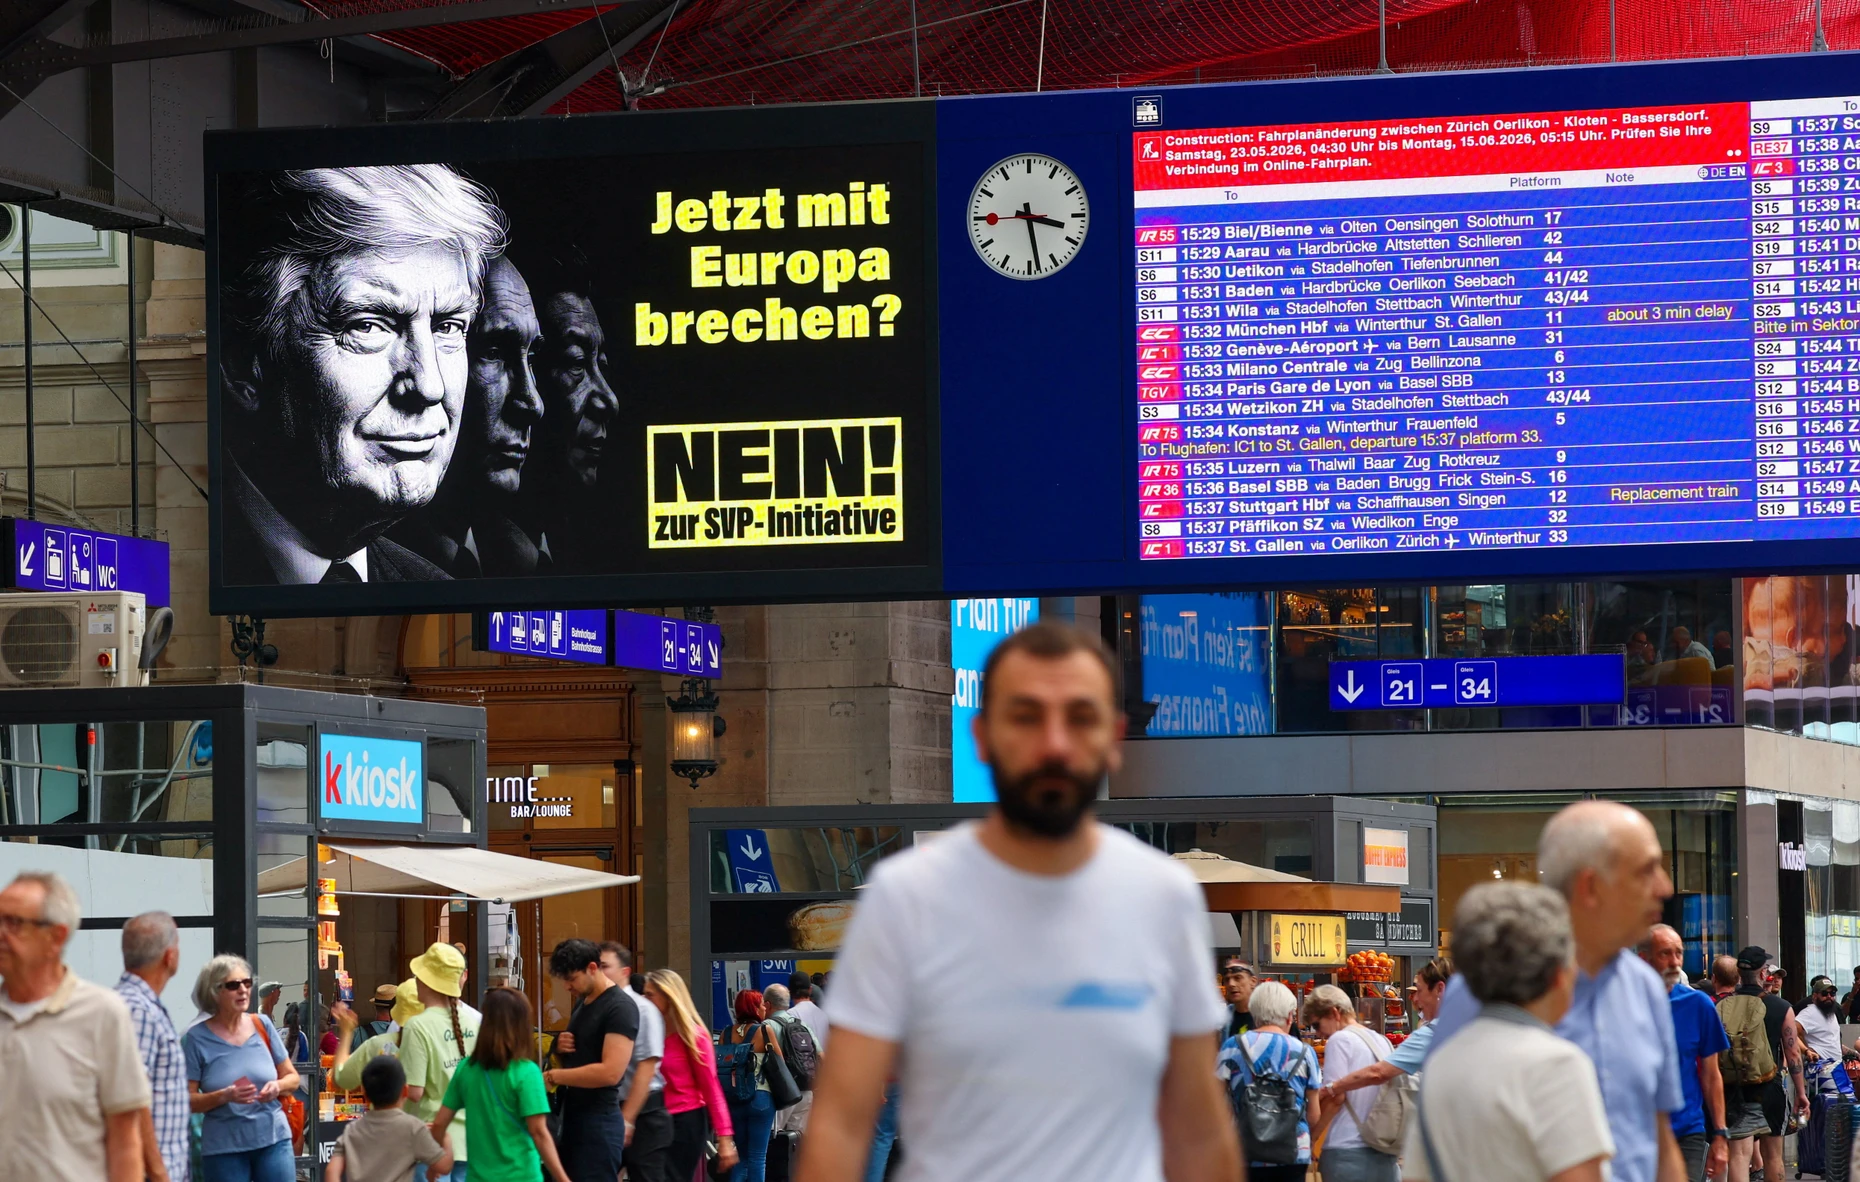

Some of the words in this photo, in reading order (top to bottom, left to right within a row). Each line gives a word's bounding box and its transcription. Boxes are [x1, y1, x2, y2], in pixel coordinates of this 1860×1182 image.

[1843, 100, 1858, 111] To
[1165, 132, 1254, 146] Construction:
[1258, 127, 1377, 143] Fahrplanänderung
[1381, 123, 1442, 136] zwischen
[1446, 120, 1489, 132] Zürich
[1493, 118, 1549, 130] Oerlikon
[1564, 116, 1607, 127] Kloten
[1622, 109, 1708, 124] Bassersdorf.
[1753, 122, 1770, 134] S9
[1797, 117, 1838, 132] 15:37
[1165, 149, 1226, 161] Samstag,
[1230, 144, 1306, 158] 23.05.2026,
[1310, 142, 1346, 154] 04:30
[1351, 141, 1374, 152] Uhr
[1378, 139, 1398, 151] bis
[1402, 138, 1456, 150] Montag,
[1460, 133, 1536, 147] 15.06.2026,
[1540, 131, 1575, 143] 05:15
[1579, 130, 1606, 141] Uhr.
[1611, 127, 1655, 139] Prüfen
[1659, 126, 1680, 137] Sie
[1685, 124, 1712, 136] Ihre
[1165, 163, 1239, 176] Verbindung
[1243, 161, 1258, 172] im
[1262, 156, 1372, 171] Online-Fahrplan.
[1774, 161, 1783, 173] 3
[1797, 158, 1840, 172] 15:38
[1224, 190, 1238, 200] To
[1510, 176, 1561, 187] Platform
[1606, 172, 1634, 183] Note
[1711, 167, 1726, 177] DE
[1729, 166, 1745, 176] EN
[652, 188, 785, 234] Jetzt
[798, 182, 890, 227] mit
[1159, 229, 1175, 242] 55
[1181, 226, 1220, 240] 15:29
[1224, 224, 1313, 240] Biel/Bienne
[1319, 224, 1334, 234] via
[1340, 220, 1377, 233] Olten
[1385, 217, 1458, 232] Oensingen
[1467, 214, 1534, 228] Solothurn
[1544, 211, 1562, 224] 17
[1140, 250, 1162, 262] S11
[1181, 246, 1220, 260] 15:29
[1224, 245, 1269, 258] Aarau
[1276, 245, 1291, 256] via
[1298, 239, 1377, 255] Hardbrücke
[1384, 237, 1450, 251] Altstetten
[1457, 234, 1522, 248] Schlieren
[1543, 231, 1562, 244] 42
[691, 246, 890, 292] Europa
[635, 294, 902, 346] brechen?
[1140, 327, 1175, 340] EC
[1182, 324, 1222, 338] 15:32
[1226, 322, 1296, 337] München
[1300, 320, 1328, 334] Hbf
[1334, 322, 1349, 332] via
[1355, 316, 1427, 331] Winterthur
[1434, 315, 1453, 328] St.
[1457, 313, 1502, 327] Gallen
[1545, 310, 1562, 324] 11
[1607, 308, 1648, 321] about
[1652, 306, 1661, 319] 3
[1665, 305, 1691, 319] min
[1695, 304, 1732, 319] delay
[1754, 320, 1787, 334] Bitte
[1791, 319, 1808, 332] im
[1812, 317, 1859, 331] Sektor
[1161, 347, 1167, 358] 1
[1183, 344, 1222, 358] 15:32
[1226, 339, 1358, 356] Genève-Aéroport
[1386, 340, 1401, 350] via
[1408, 336, 1440, 349] Bern
[1449, 334, 1516, 348] Lausanne
[1545, 330, 1562, 344] 31
[1141, 386, 1168, 398] TGV
[1183, 383, 1223, 397] 15:34
[1227, 382, 1266, 396] Paris
[1270, 381, 1307, 394] Gare
[1311, 379, 1330, 392] de
[1335, 378, 1371, 393] Lyon
[1378, 380, 1393, 390] via
[1399, 375, 1437, 389] Basel
[1441, 373, 1473, 387] SBB
[1546, 370, 1565, 383] 13
[1139, 443, 1157, 456] To
[1160, 441, 1230, 456] Flughafen:
[1234, 440, 1254, 453] IC1
[1258, 440, 1272, 452] to
[1276, 438, 1294, 451] St.
[1299, 437, 1346, 451] Gallen,
[1350, 435, 1417, 450] departure
[1420, 432, 1456, 446] 15:37
[1460, 431, 1517, 447] platform
[1521, 429, 1542, 443] 33.
[653, 425, 896, 503] NEIN!
[1185, 501, 1224, 515] 15:37
[1228, 499, 1298, 514] Stuttgart
[1302, 497, 1330, 511] Hbf
[1336, 500, 1351, 510] via
[1357, 495, 1450, 509] Schaffhausen
[1458, 492, 1505, 508] Singen
[1548, 489, 1567, 503] 12
[1611, 486, 1704, 503] Replacement
[1706, 484, 1738, 498] train
[1760, 503, 1784, 515] S19
[1804, 500, 1846, 514] 15:49
[655, 513, 700, 540] zur
[704, 502, 896, 539] SVP-Initiative
[98, 565, 116, 588] WC
[665, 640, 674, 662] 21
[690, 643, 701, 666] 34
[1390, 680, 1413, 700] 21
[1461, 678, 1491, 699] 34
[510, 805, 572, 817] BAR/LOUNGE
[1291, 922, 1326, 958] GRILL
